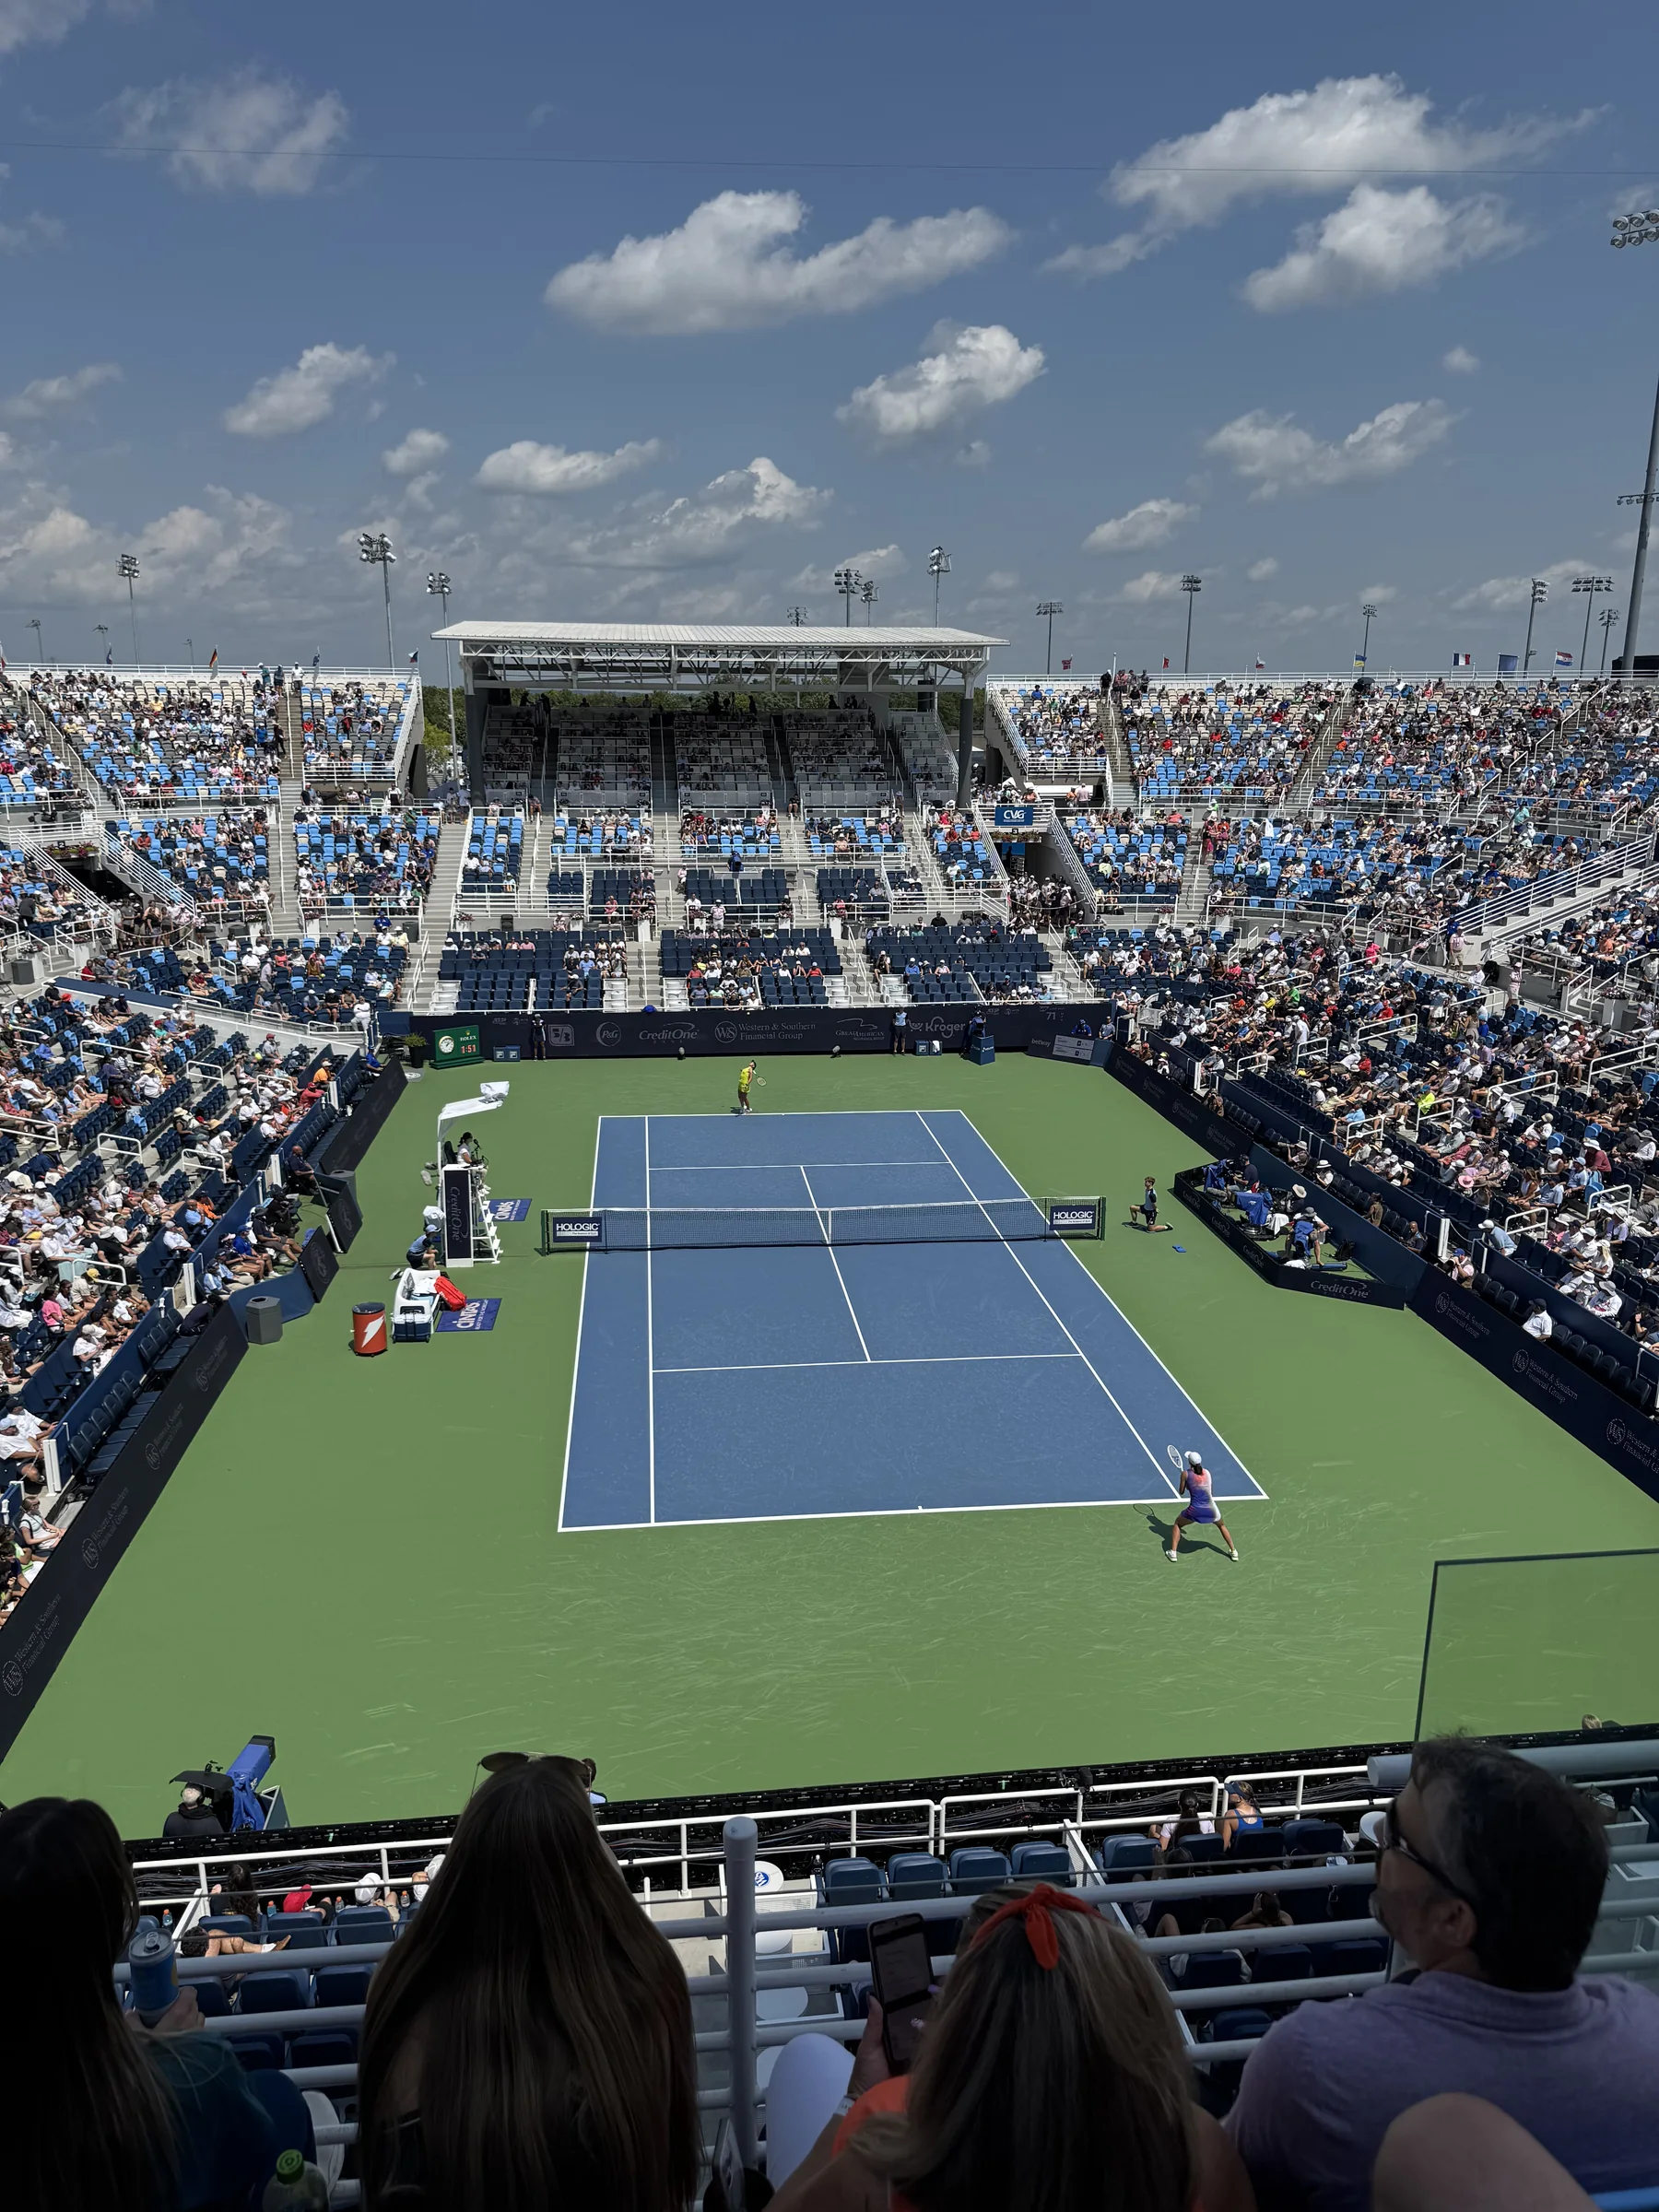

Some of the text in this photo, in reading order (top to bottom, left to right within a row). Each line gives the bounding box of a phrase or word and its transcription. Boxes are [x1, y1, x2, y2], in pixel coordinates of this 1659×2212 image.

[1004, 809, 1026, 819] CVG
[1046, 1011, 1056, 1020] 71
[738, 1021, 816, 1031] Western & Southern
[925, 1017, 966, 1039] Kroger
[602, 1030, 618, 1039] P&G
[639, 1029, 698, 1040] CreditOne
[740, 1031, 804, 1041] Financial Group
[1031, 1038, 1052, 1048] betway
[461, 1044, 477, 1054] 1:51
[450, 1186, 463, 1241] CreditOne
[1053, 1211, 1094, 1219] HOLOGIC
[556, 1223, 599, 1231] HOLOGIC
[1311, 1280, 1370, 1299] CreditOne
